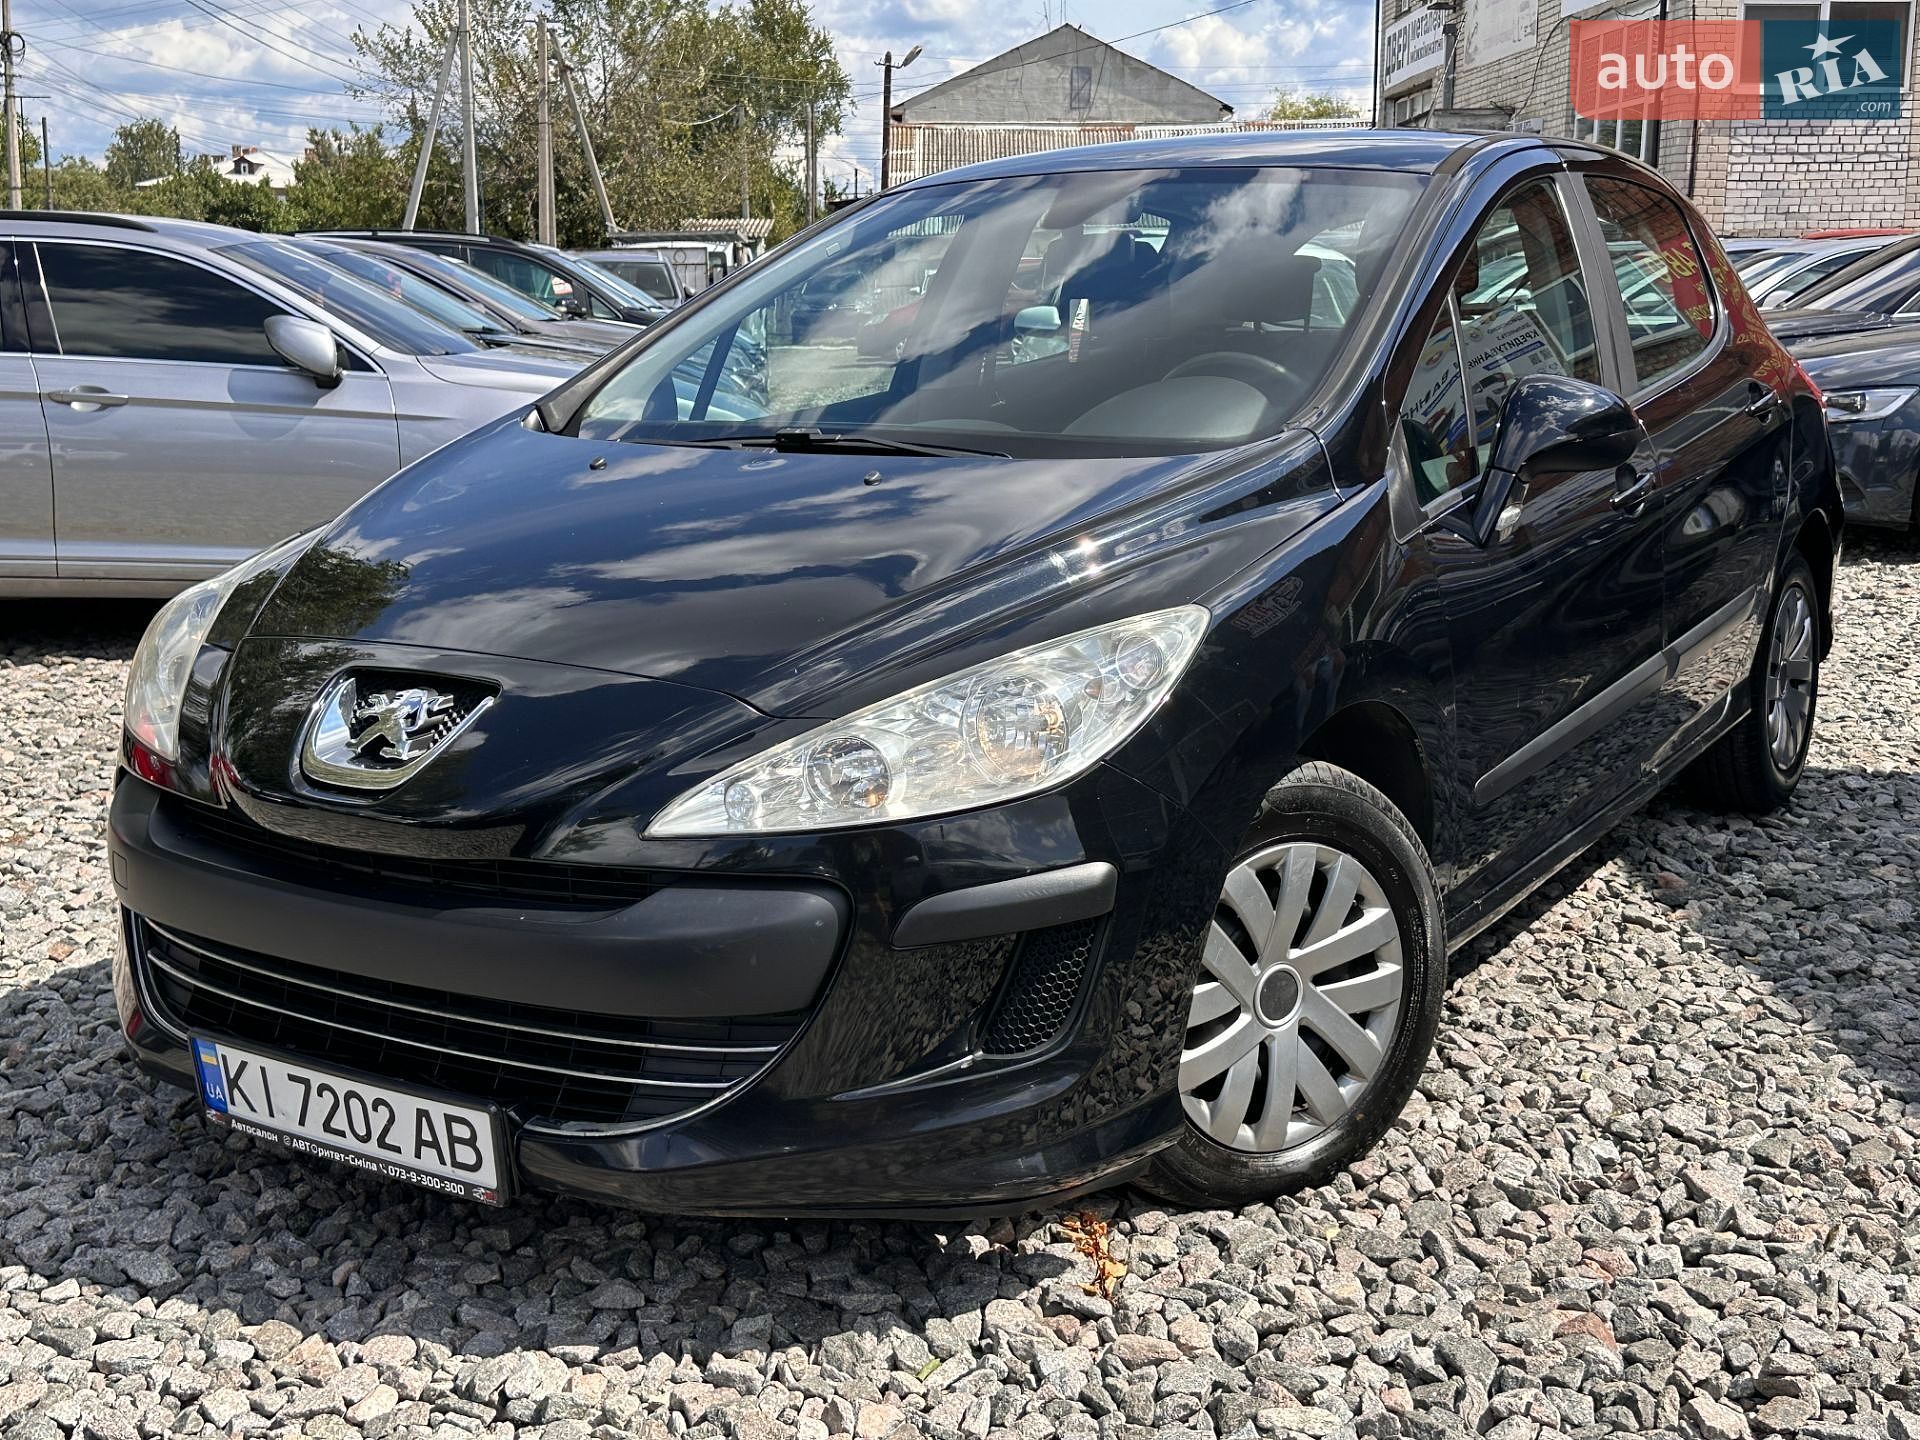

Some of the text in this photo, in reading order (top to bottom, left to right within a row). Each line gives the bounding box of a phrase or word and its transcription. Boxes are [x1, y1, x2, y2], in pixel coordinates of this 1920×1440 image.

[206, 1081, 225, 1101] UA
[221, 1053, 483, 1173] KI 7202 AB
[231, 1118, 278, 1142] Автосалон
[388, 1165, 465, 1196] 073-9-300-300
